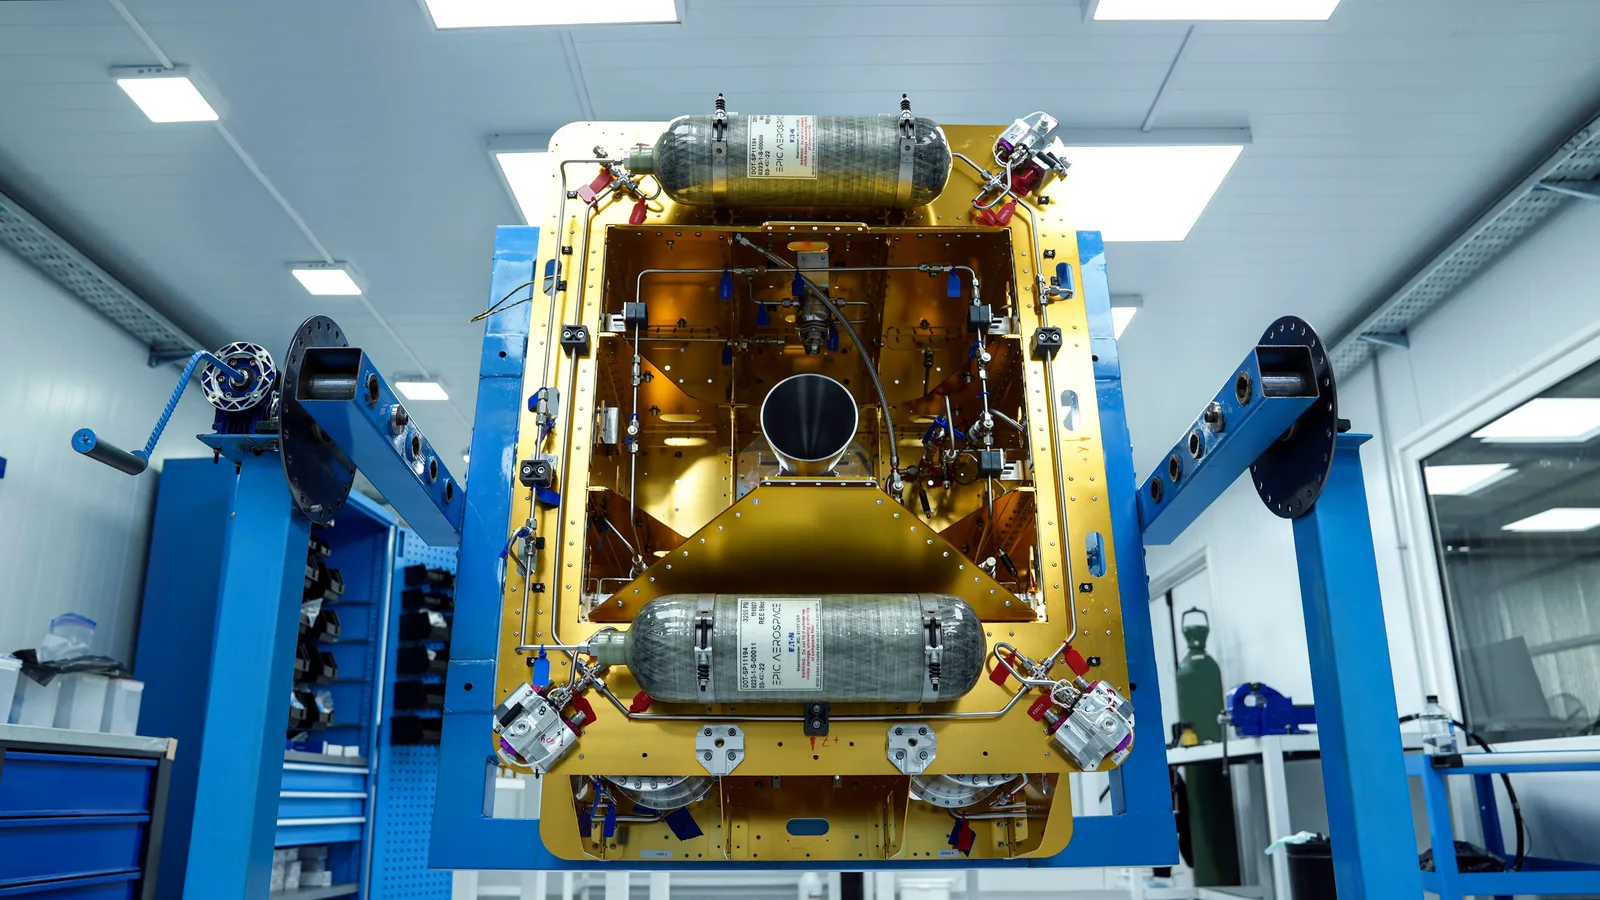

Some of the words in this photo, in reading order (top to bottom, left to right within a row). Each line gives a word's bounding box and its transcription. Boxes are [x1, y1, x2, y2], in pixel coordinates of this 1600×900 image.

[776, 152, 784, 172] EPIC
[772, 604, 781, 661] AEROSPACE
[773, 664, 781, 685] EPIC
